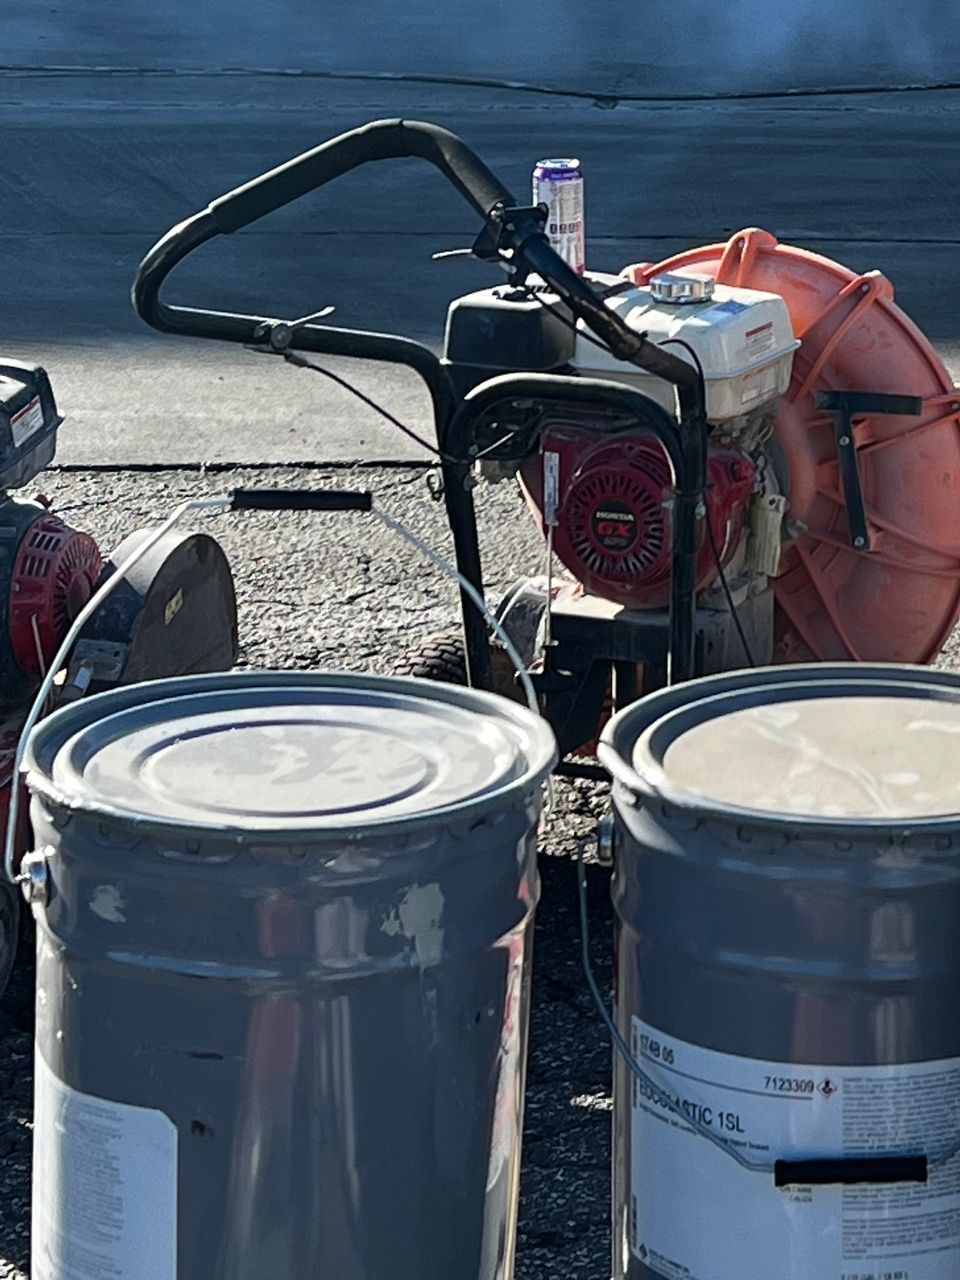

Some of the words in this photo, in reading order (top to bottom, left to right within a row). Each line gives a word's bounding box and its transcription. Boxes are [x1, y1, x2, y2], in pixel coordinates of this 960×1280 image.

[595, 511, 635, 522] HONDA
[597, 522, 631, 537] GX
[764, 1076, 815, 1094] 7123309
[718, 1111, 746, 1133] 1SL
